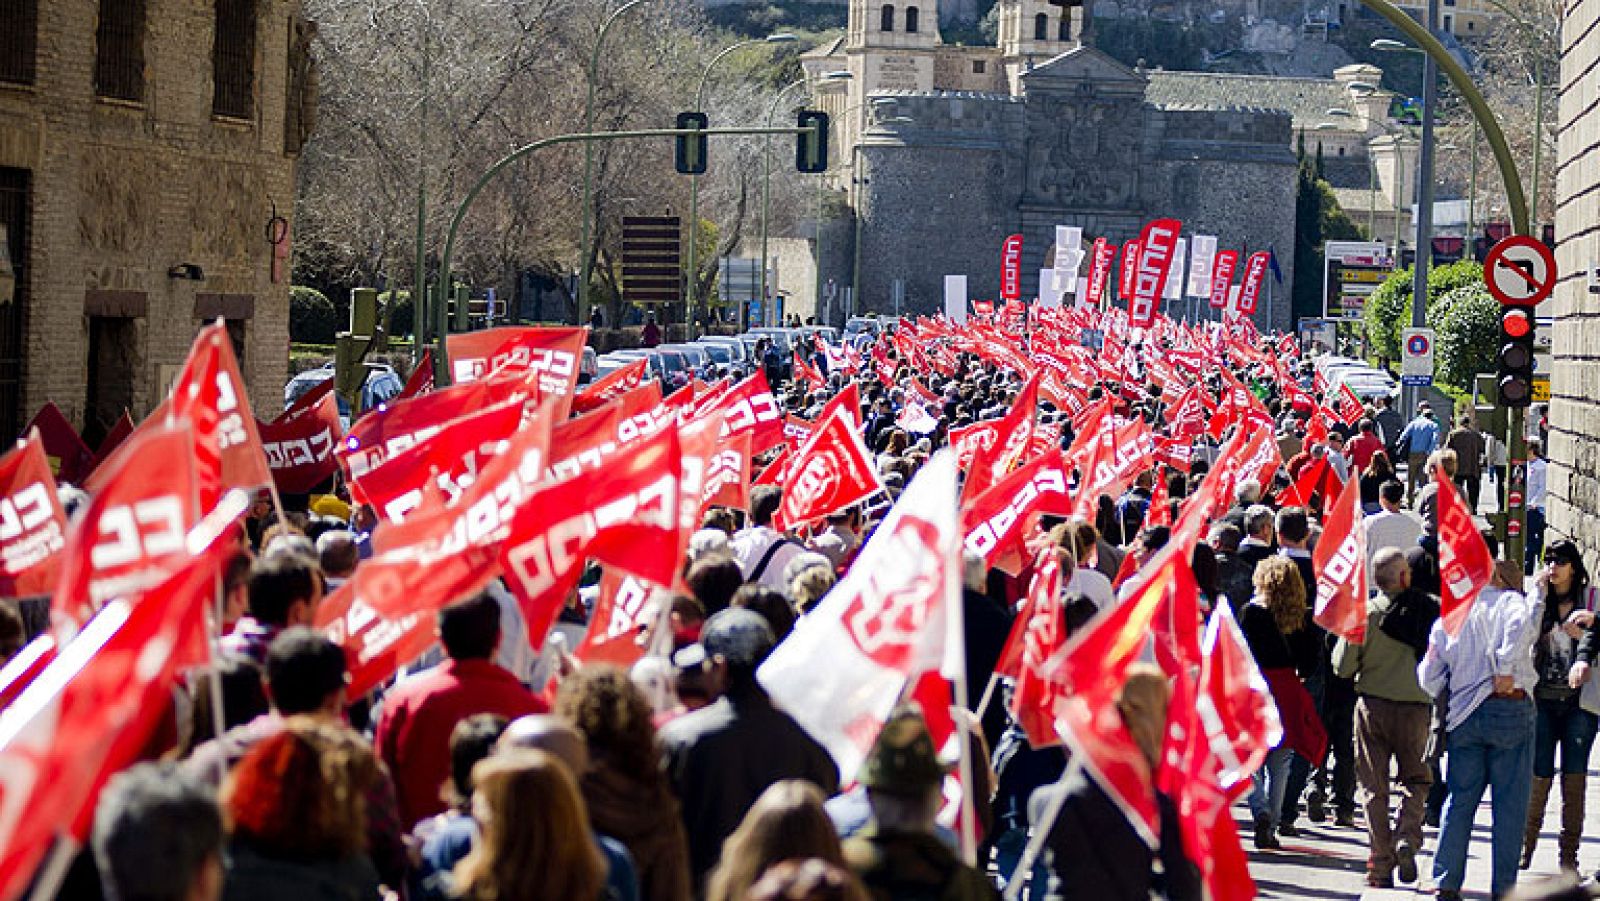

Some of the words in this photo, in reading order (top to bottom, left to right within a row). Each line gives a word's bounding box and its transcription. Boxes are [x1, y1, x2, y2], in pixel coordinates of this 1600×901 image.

[1005, 240, 1020, 295] CCOO
[1133, 226, 1173, 320] CCOO
[1212, 253, 1233, 305] CCOO
